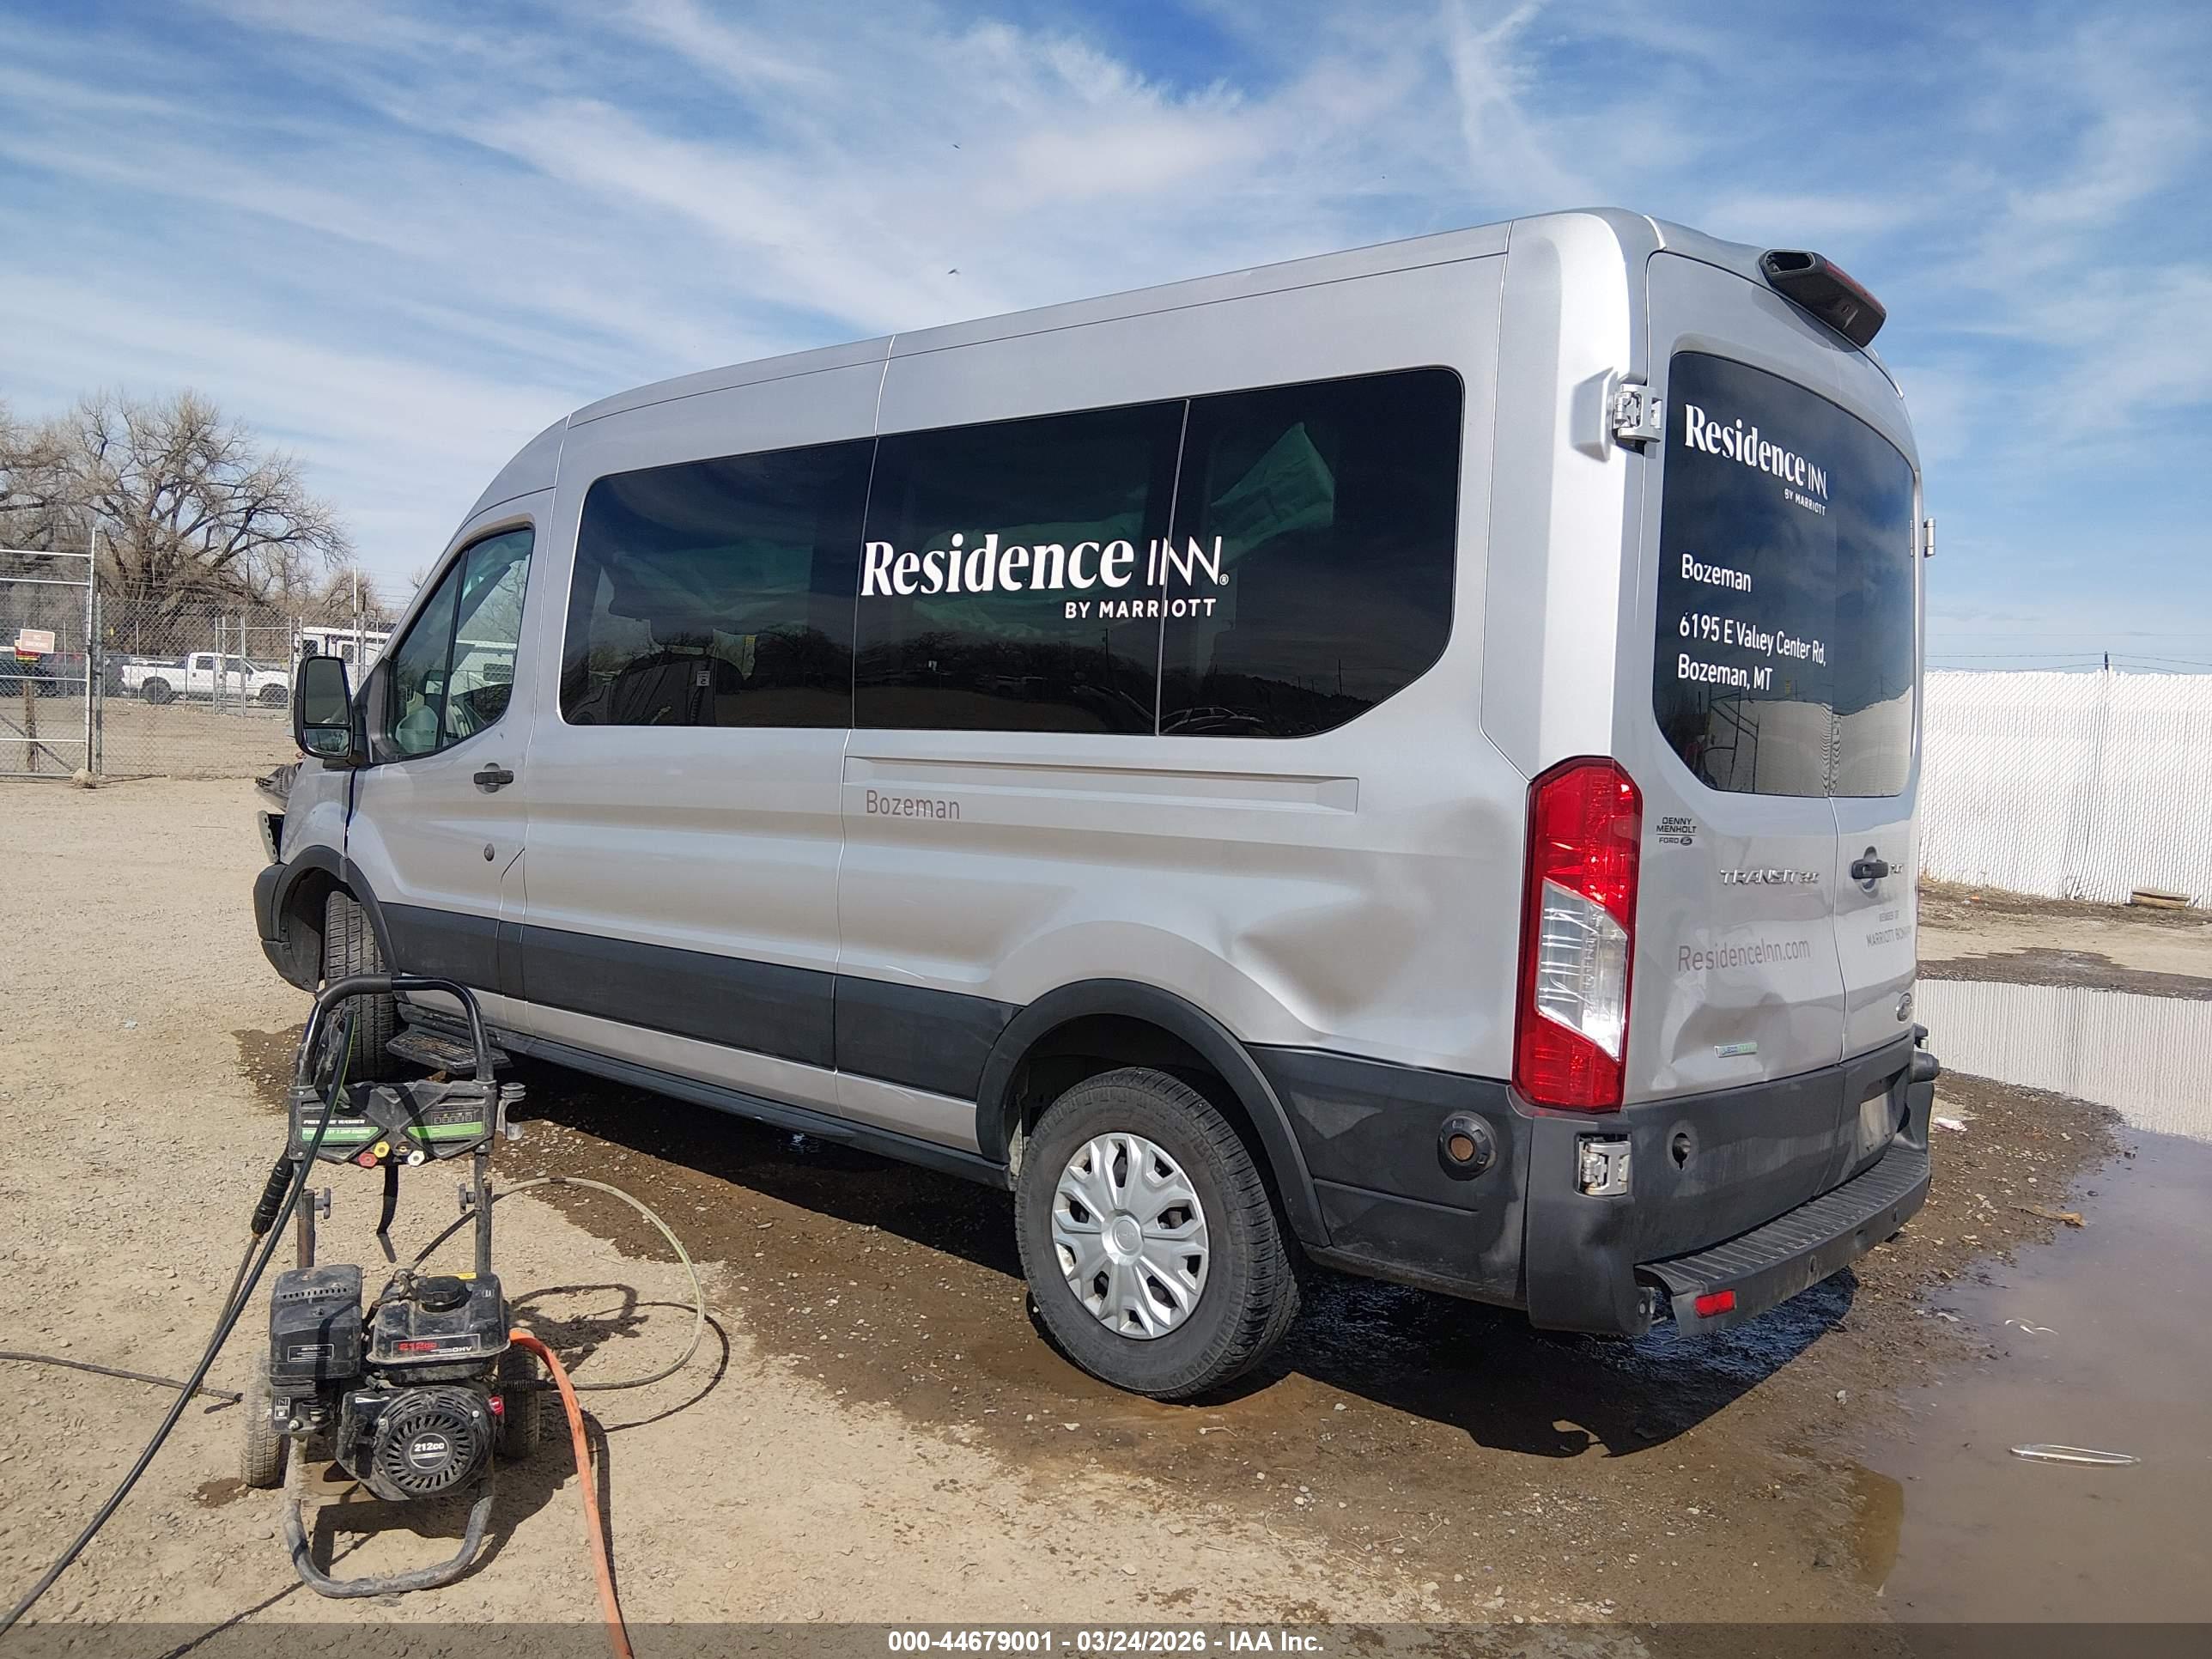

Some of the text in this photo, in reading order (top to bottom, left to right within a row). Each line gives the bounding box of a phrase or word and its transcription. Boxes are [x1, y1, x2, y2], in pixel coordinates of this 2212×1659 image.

[1685, 404, 1806, 487] Residence
[1784, 488, 1826, 515] BY MARRIOTT
[860, 532, 1134, 597] Residence
[1681, 553, 1752, 593] Bozeman
[1065, 599, 1217, 619] BY MARRIOTT
[1679, 612, 1720, 642] 6195
[1724, 619, 1735, 644] E
[1736, 621, 1774, 657] Valley
[1777, 630, 1811, 659] Center
[1677, 653, 1773, 691] Bozeman, MT
[866, 788, 961, 820] Bozeman
[1656, 824, 1698, 834] MENHOLT
[1662, 817, 1692, 825] DENNY
[1719, 868, 1796, 885] TRANSIT
[1677, 938, 1812, 972] ResidenceInn.com
